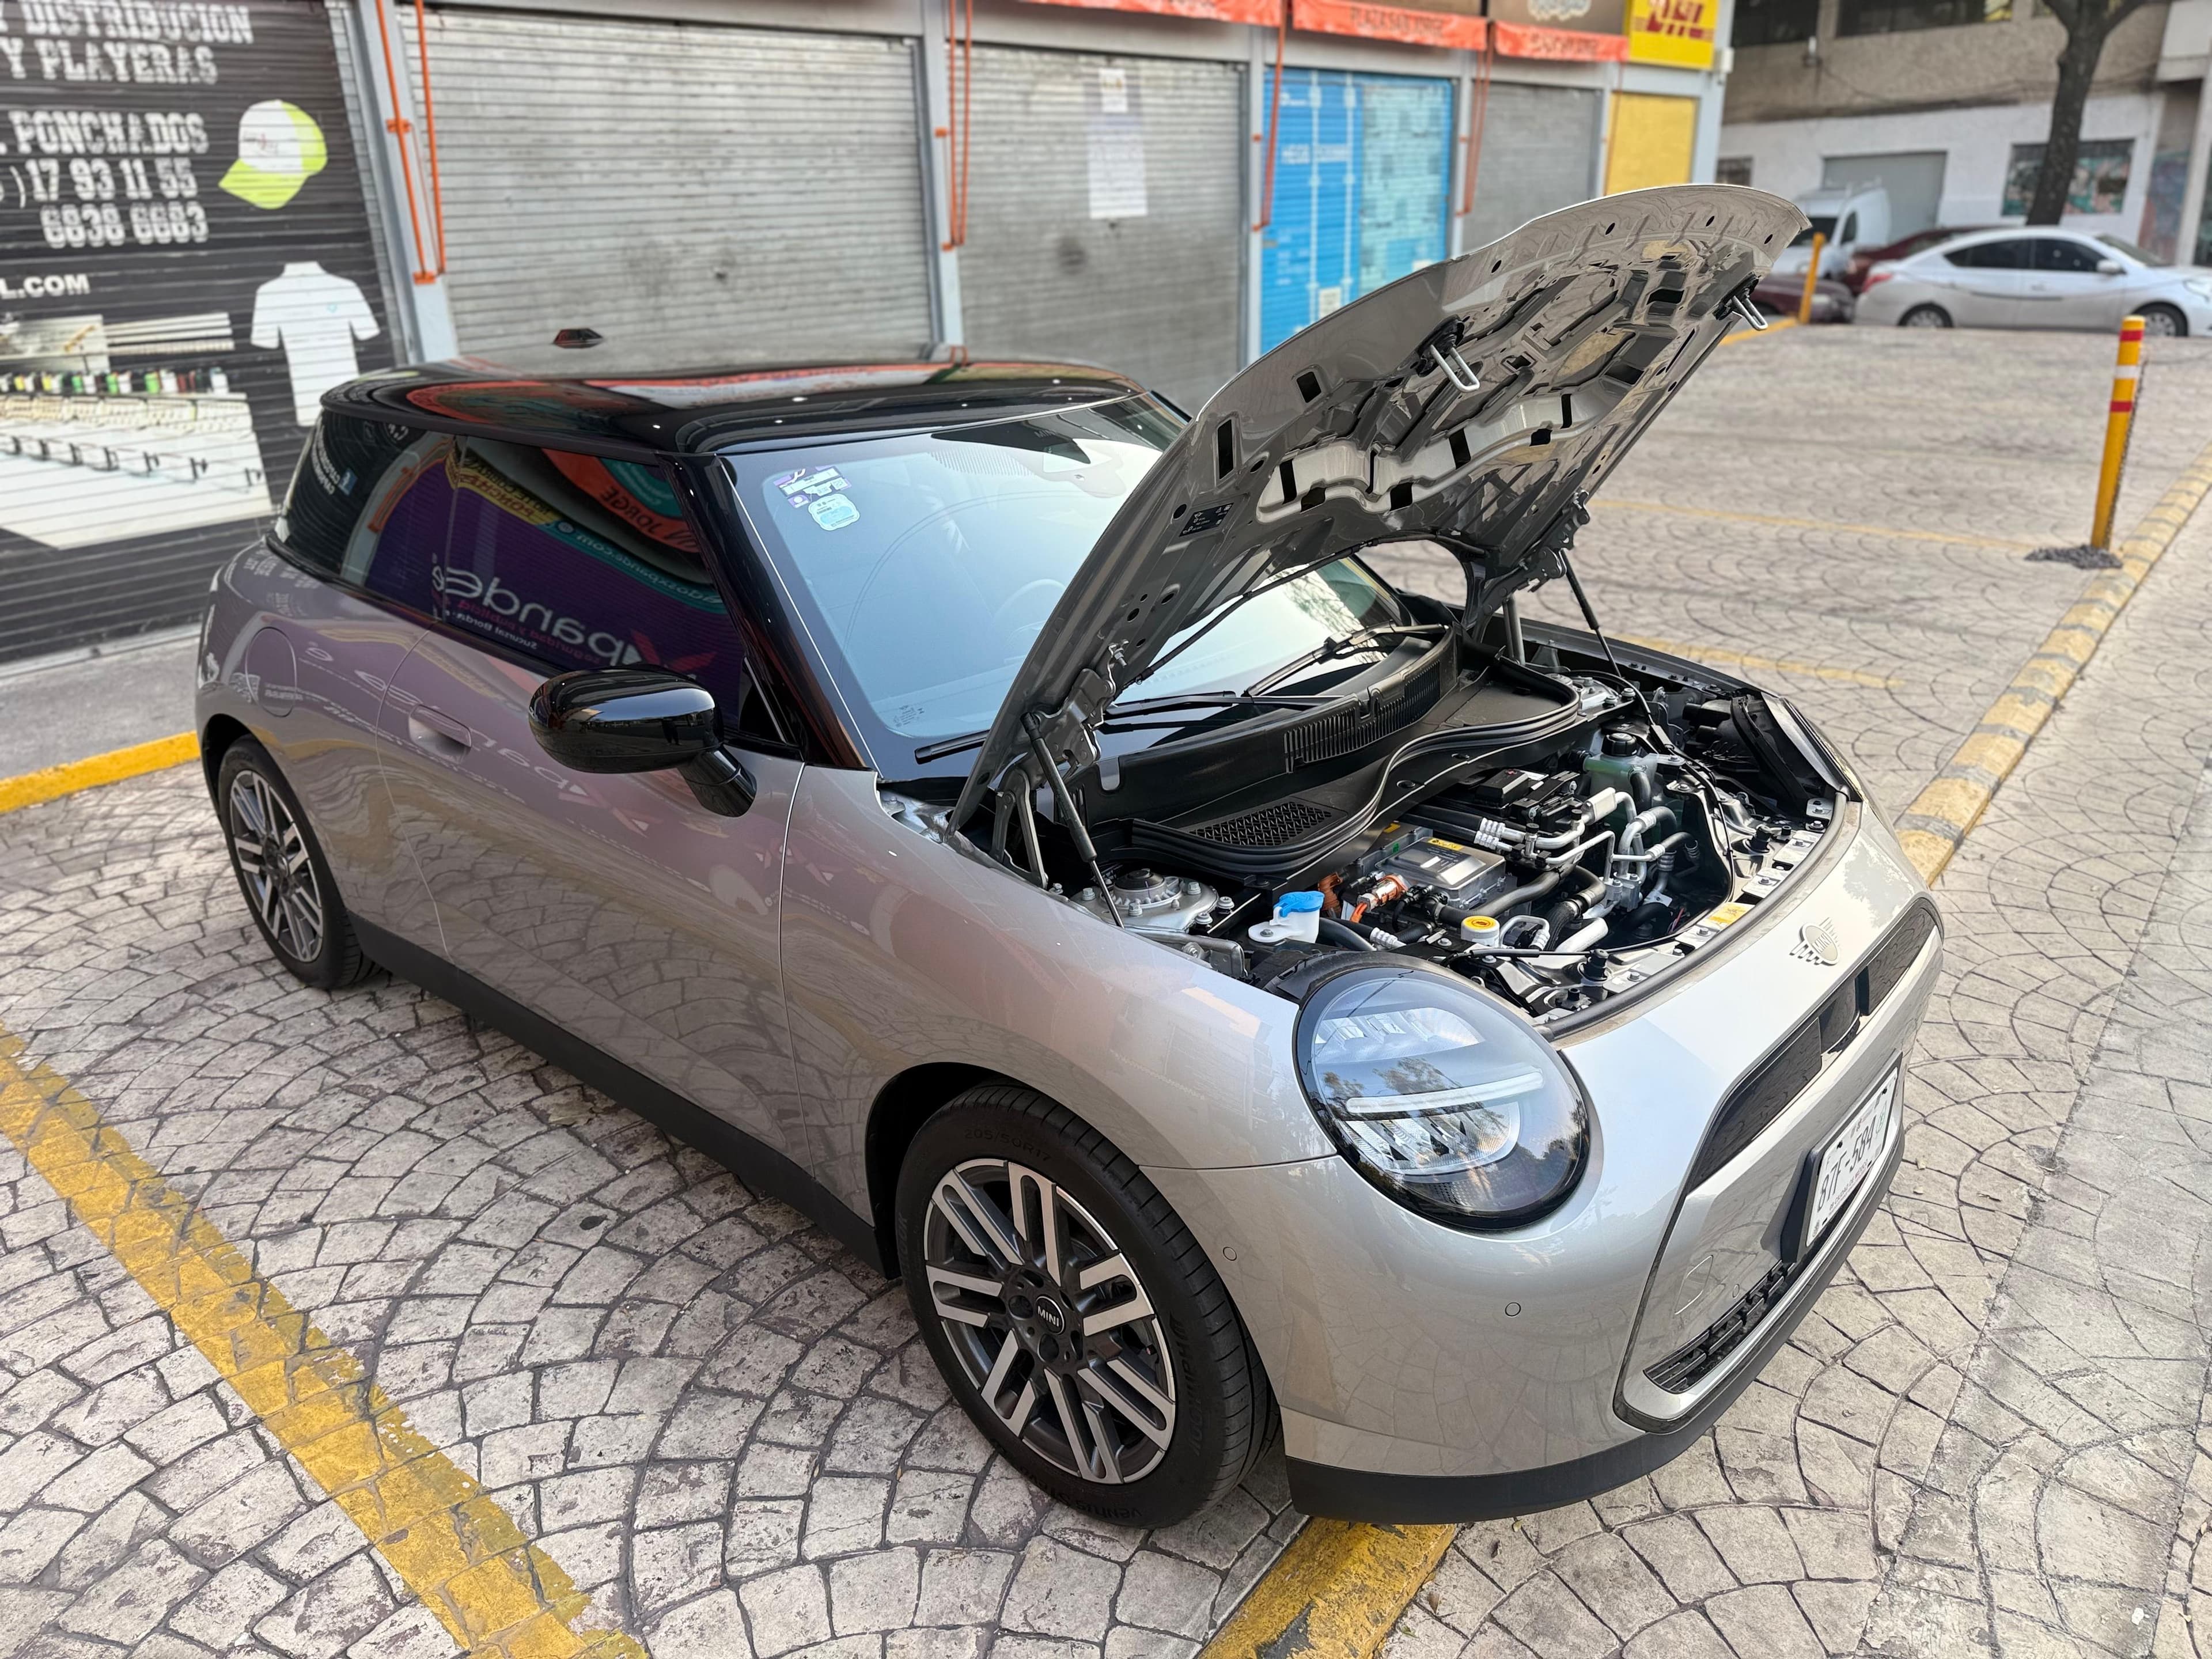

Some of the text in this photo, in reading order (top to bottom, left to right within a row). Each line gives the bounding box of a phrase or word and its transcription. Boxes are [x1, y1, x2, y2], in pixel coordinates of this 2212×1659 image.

[20, 0, 254, 43] DISTRIBUCION
[33, 38, 218, 85] PLAYERAS
[8, 109, 209, 154] PONCHADOS
[69, 158, 115, 200] 93
[119, 158, 153, 200] 11
[154, 157, 198, 199] 55
[1810, 931, 1832, 956] MINI
[1037, 1305, 1059, 1327] MINI
